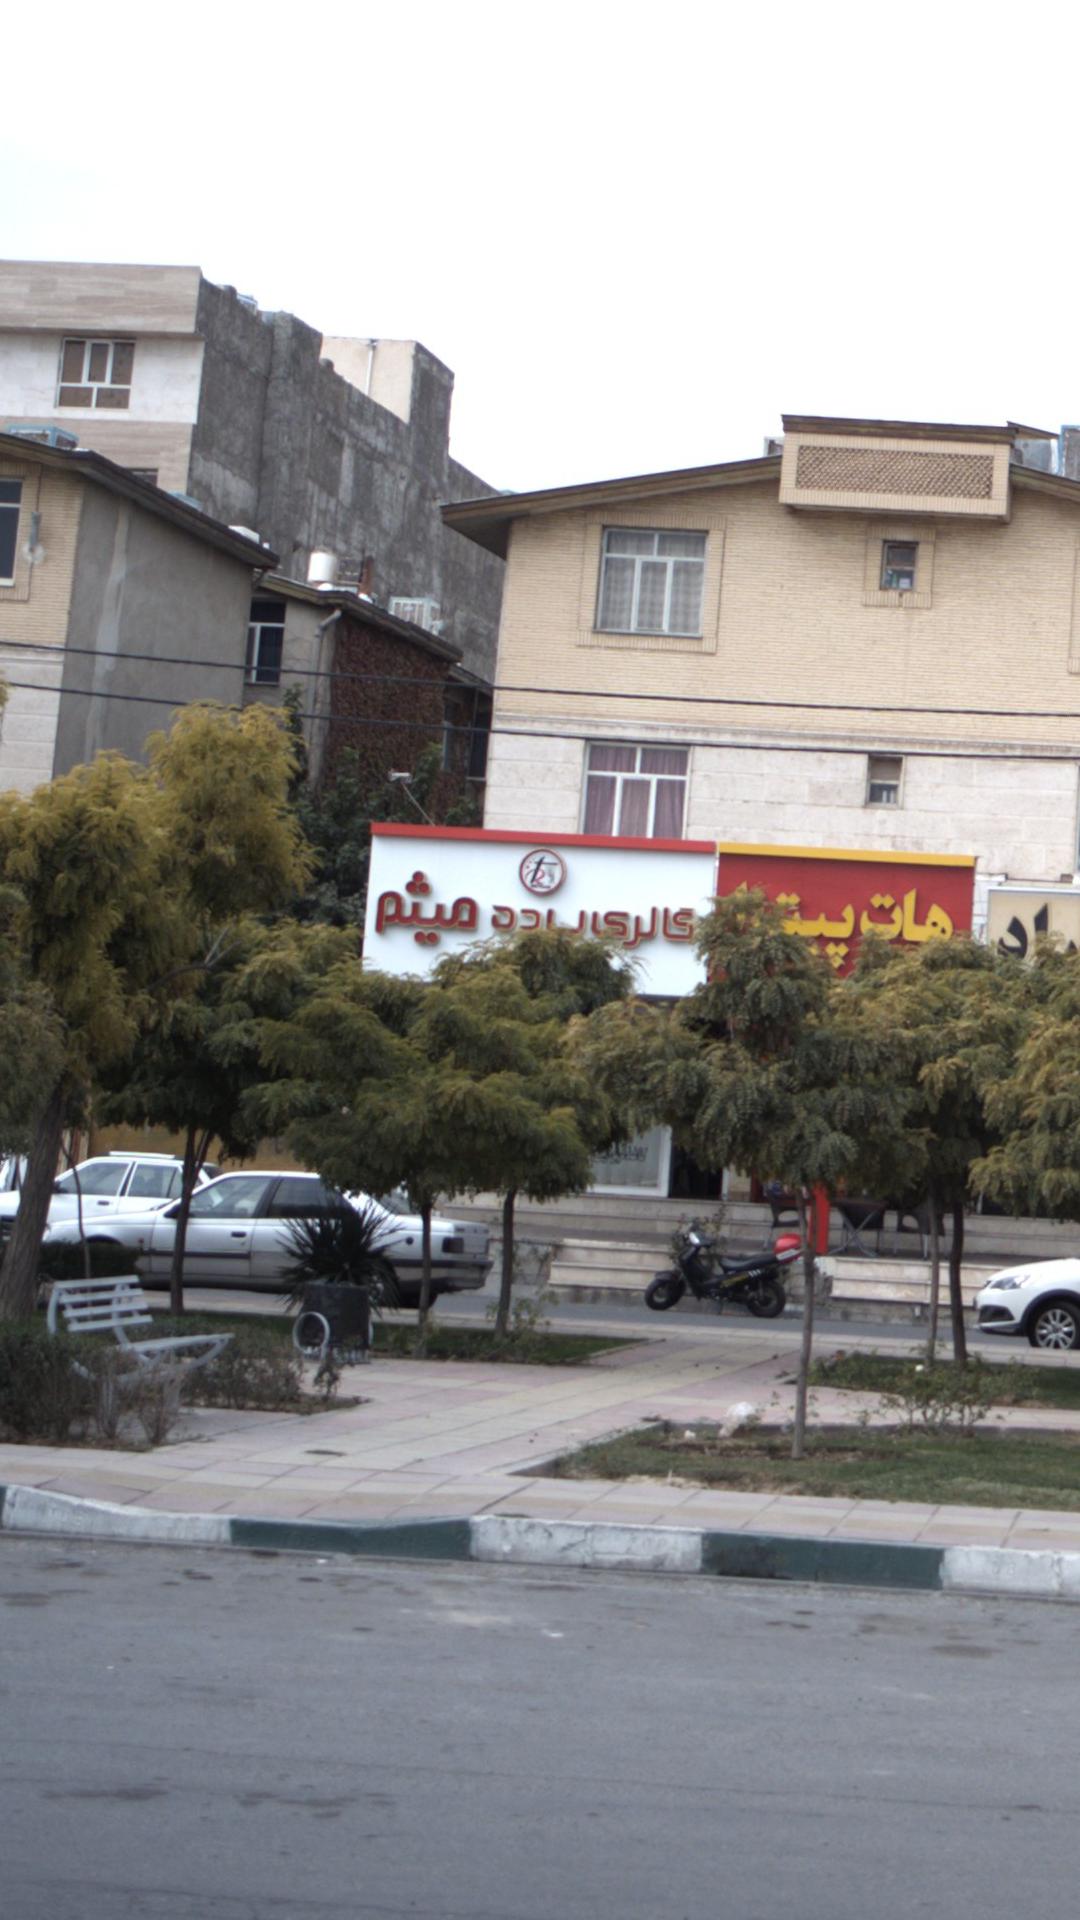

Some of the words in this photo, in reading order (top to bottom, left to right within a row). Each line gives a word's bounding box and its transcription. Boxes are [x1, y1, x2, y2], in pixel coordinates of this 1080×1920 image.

[375, 871, 478, 945] میثم
[591, 906, 695, 948] گالری
[735, 880, 855, 969] پیت
[859, 888, 954, 943] هات
